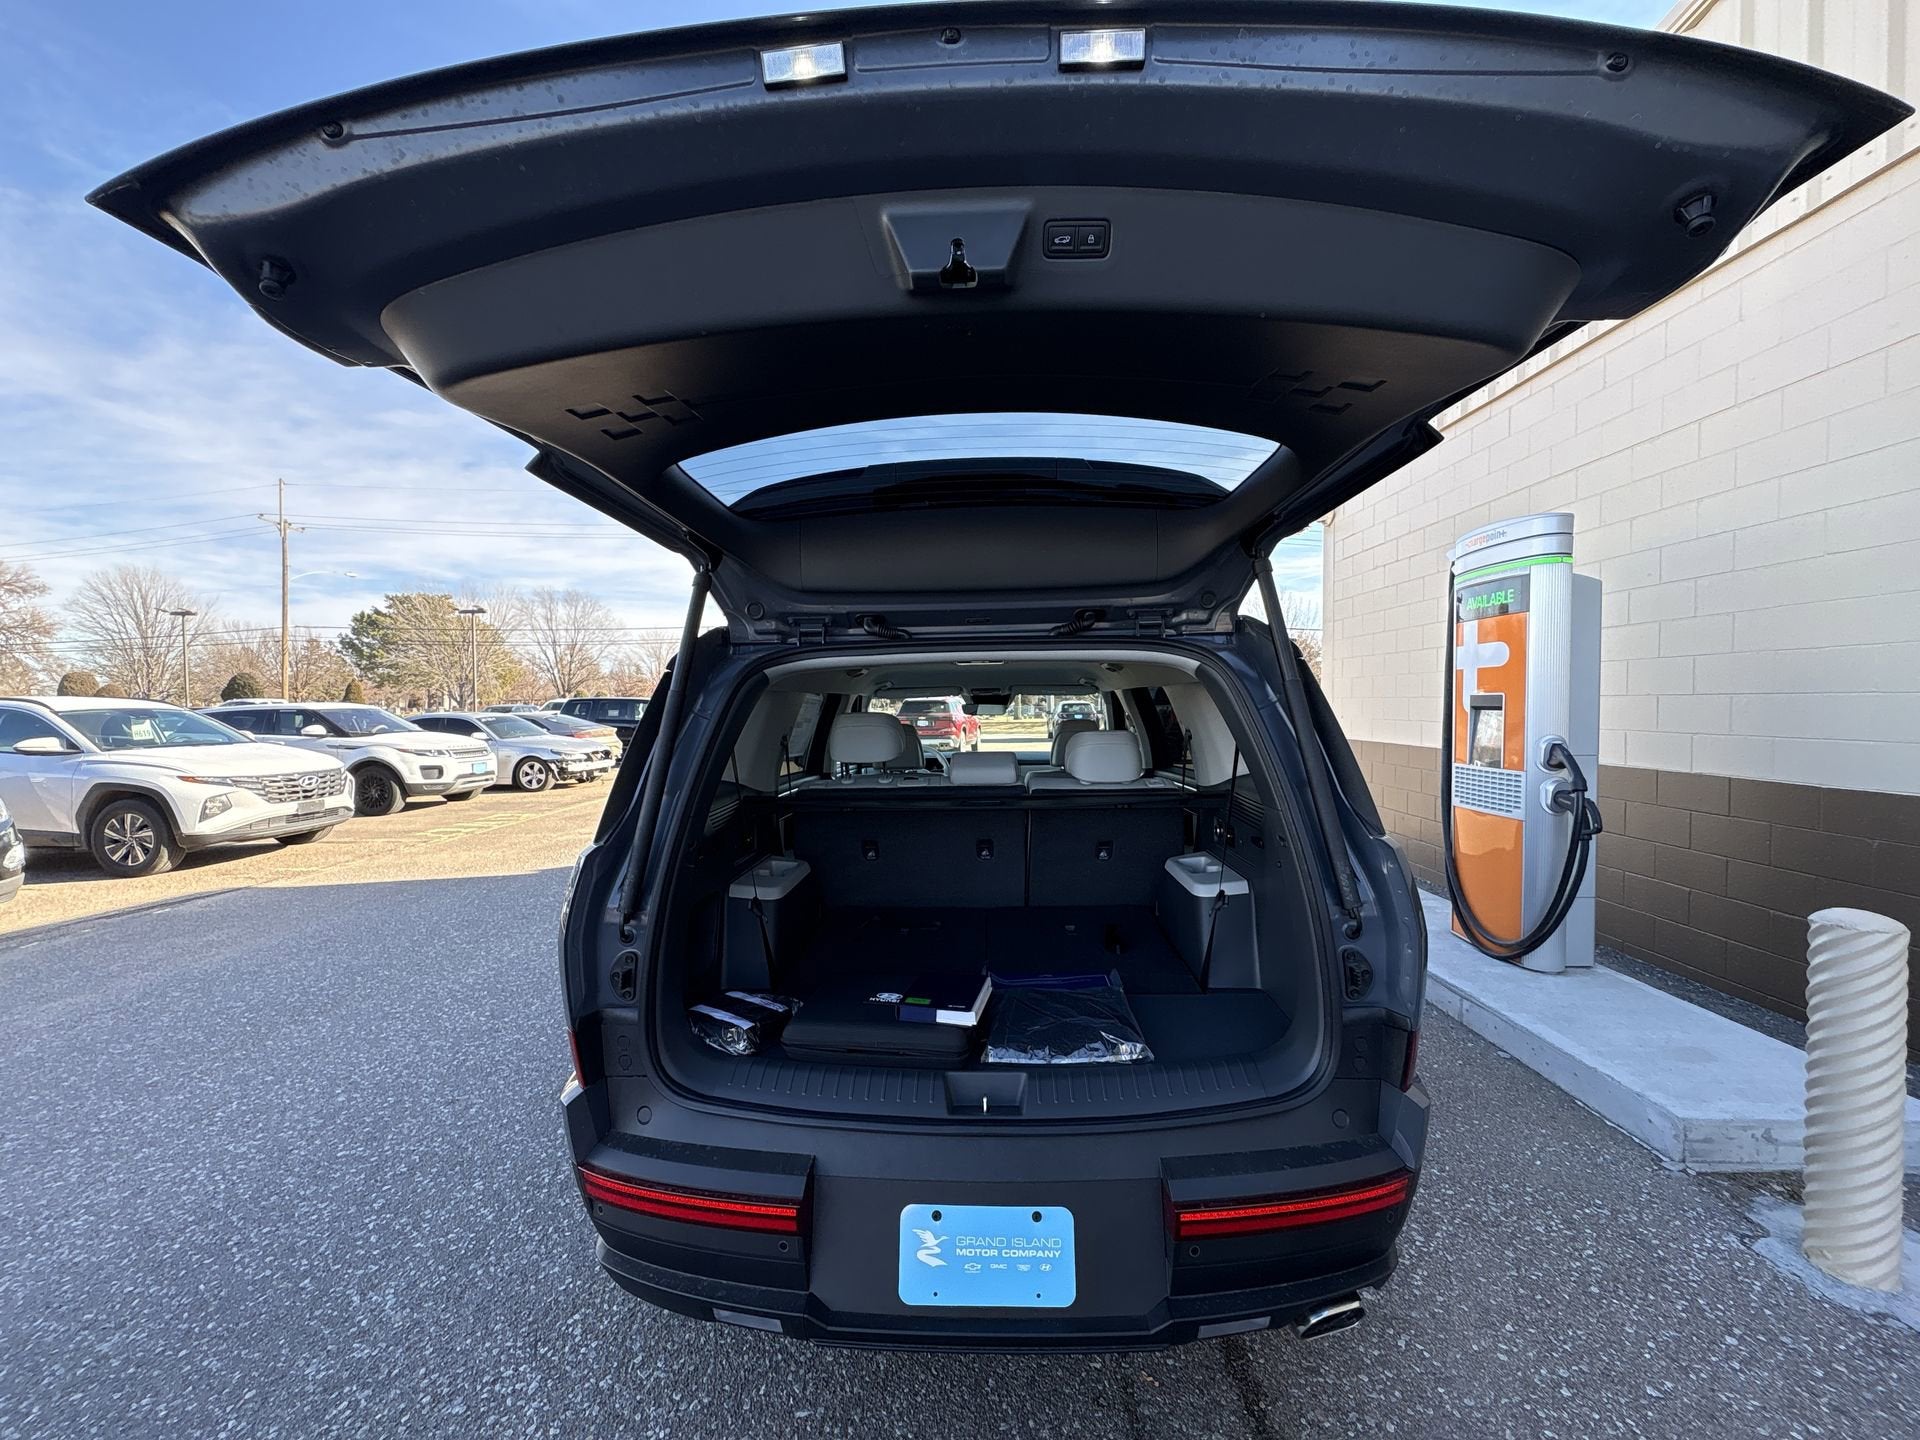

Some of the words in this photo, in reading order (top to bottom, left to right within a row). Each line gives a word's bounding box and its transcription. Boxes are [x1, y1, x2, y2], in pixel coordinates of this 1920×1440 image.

[1467, 589, 1514, 609] AVAILABLE
[956, 1236, 1007, 1247] GRAND
[1011, 1237, 1062, 1248] ISLAND
[956, 1248, 998, 1257] MOTOR
[1002, 1249, 1061, 1258] COMPANY
